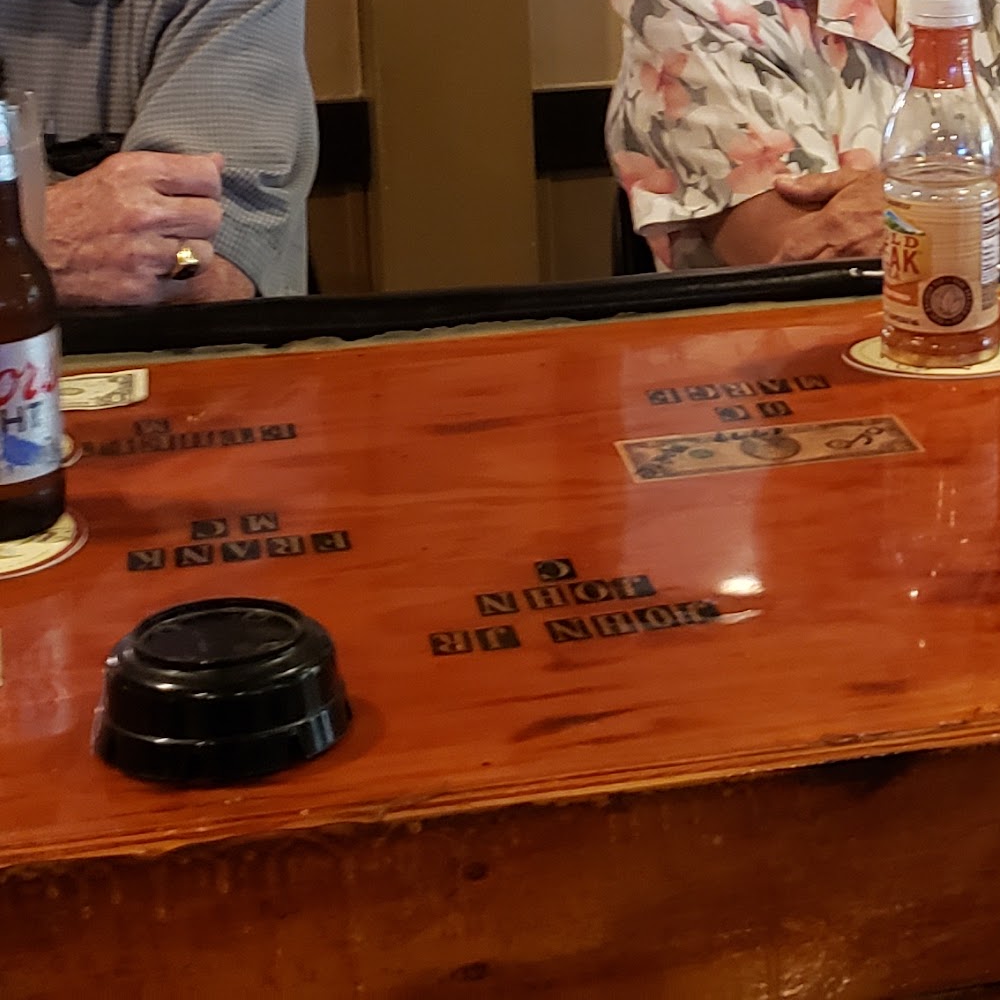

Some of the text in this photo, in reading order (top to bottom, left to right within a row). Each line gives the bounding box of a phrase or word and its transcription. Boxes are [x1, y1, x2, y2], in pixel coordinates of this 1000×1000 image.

[128, 530, 351, 571] FRANK
[535, 559, 574, 582] C
[476, 574, 656, 616] JOHN
[430, 625, 521, 657] JR
[544, 601, 721, 643] JOHN
